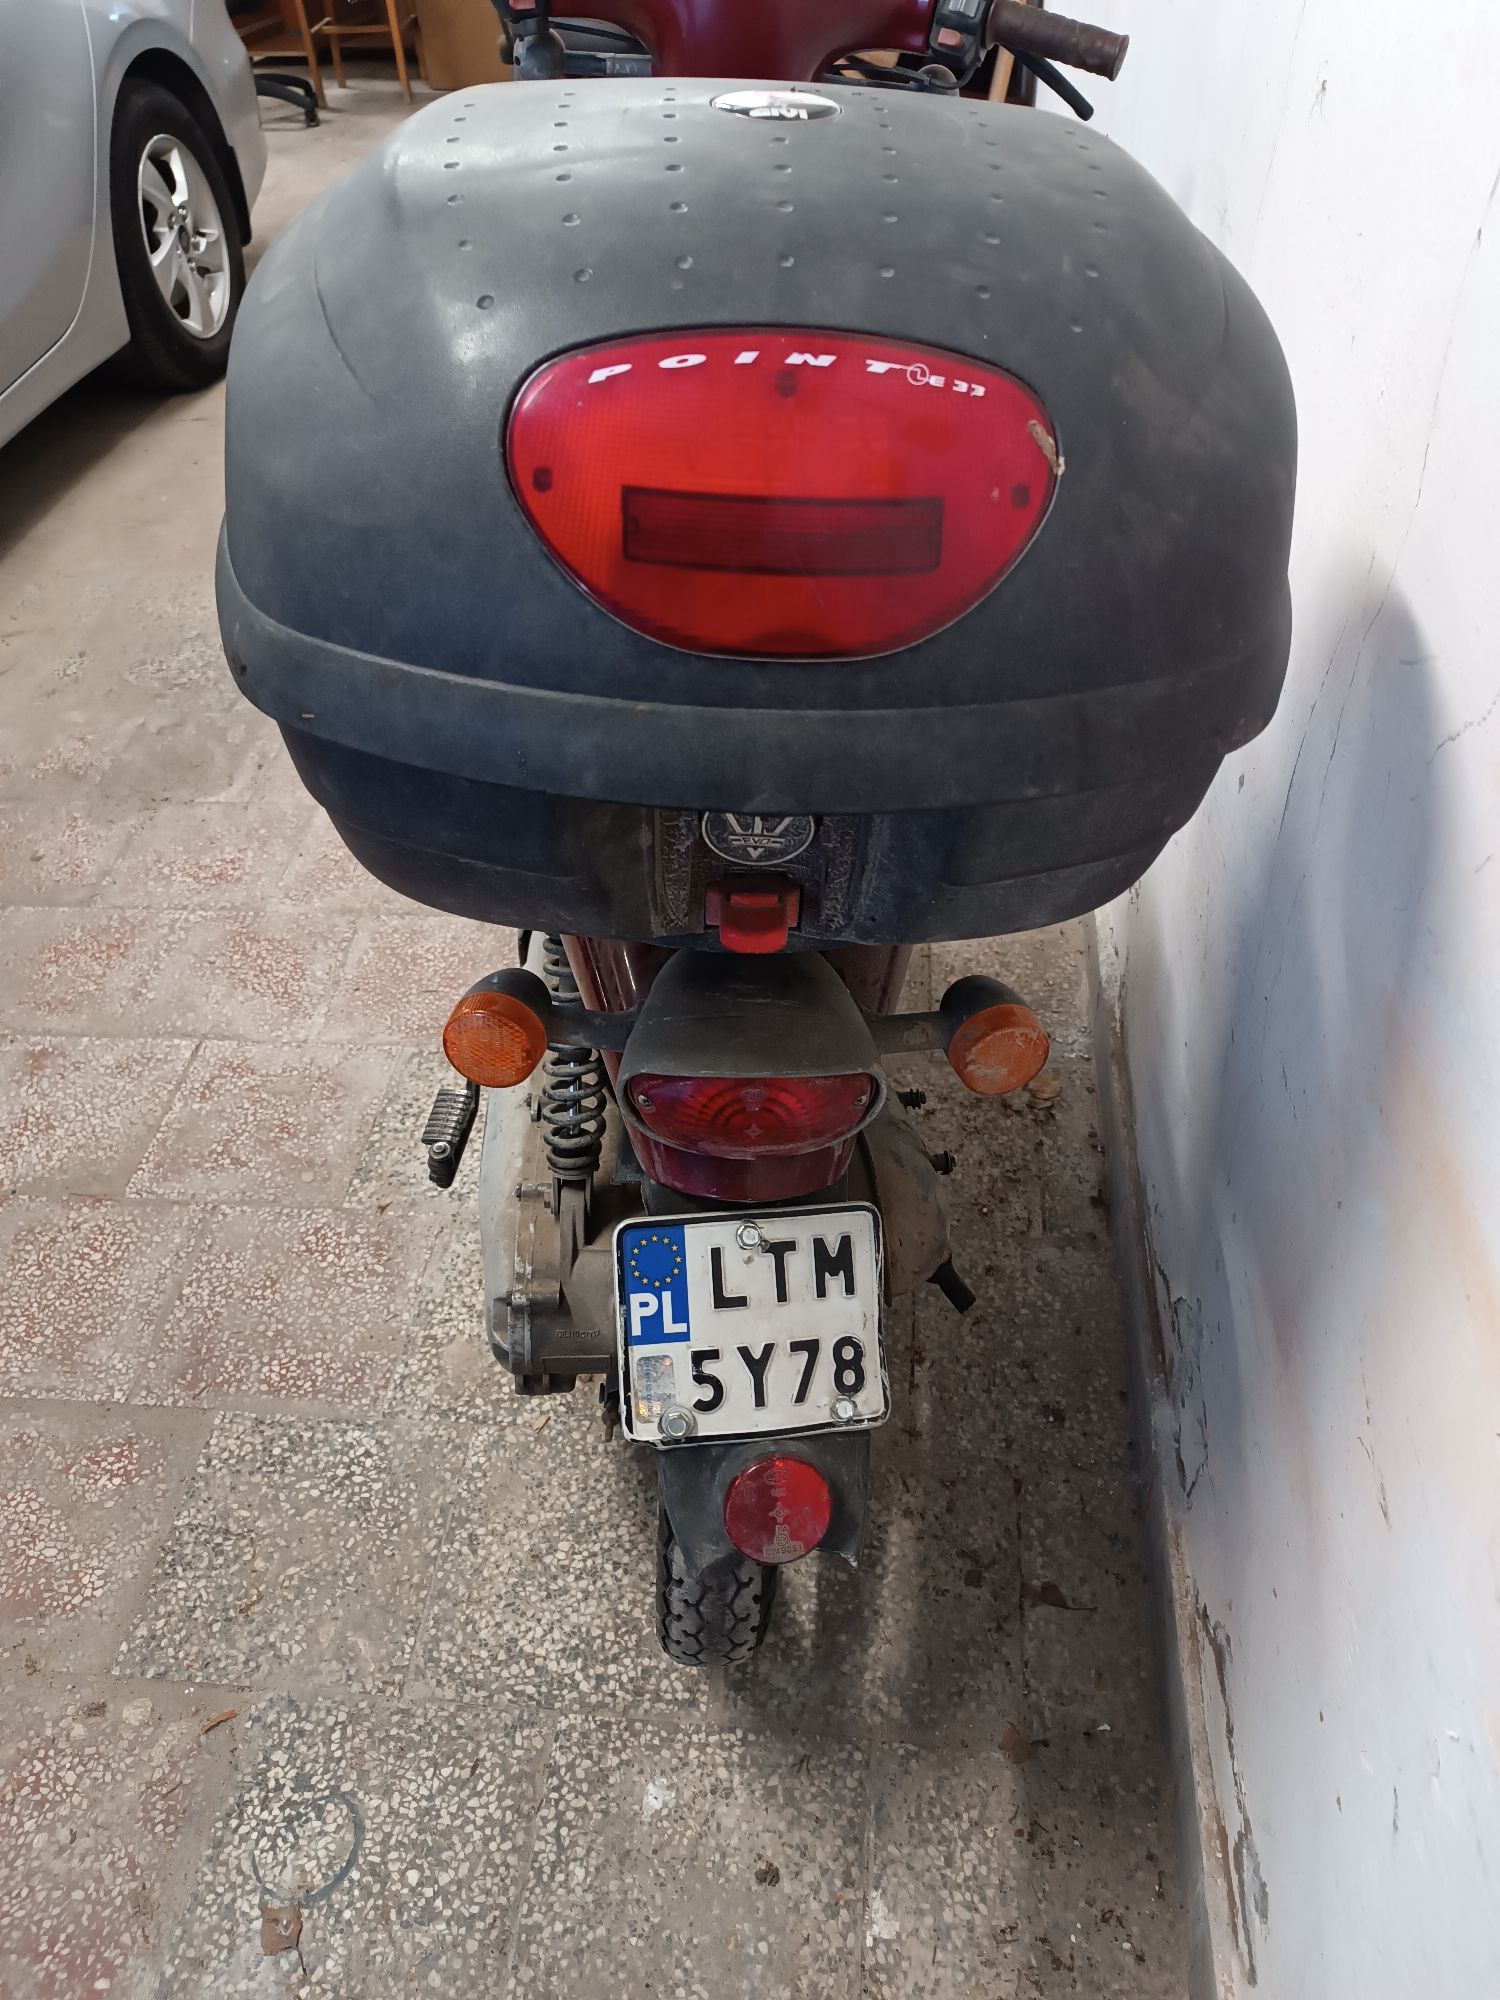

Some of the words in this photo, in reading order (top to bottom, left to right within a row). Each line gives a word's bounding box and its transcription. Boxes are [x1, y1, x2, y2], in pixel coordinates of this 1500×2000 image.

[588, 350, 900, 384] POINT
[710, 1234, 856, 1310] LTM
[629, 1290, 688, 1337] PL
[690, 1335, 866, 1413] 5Y78
